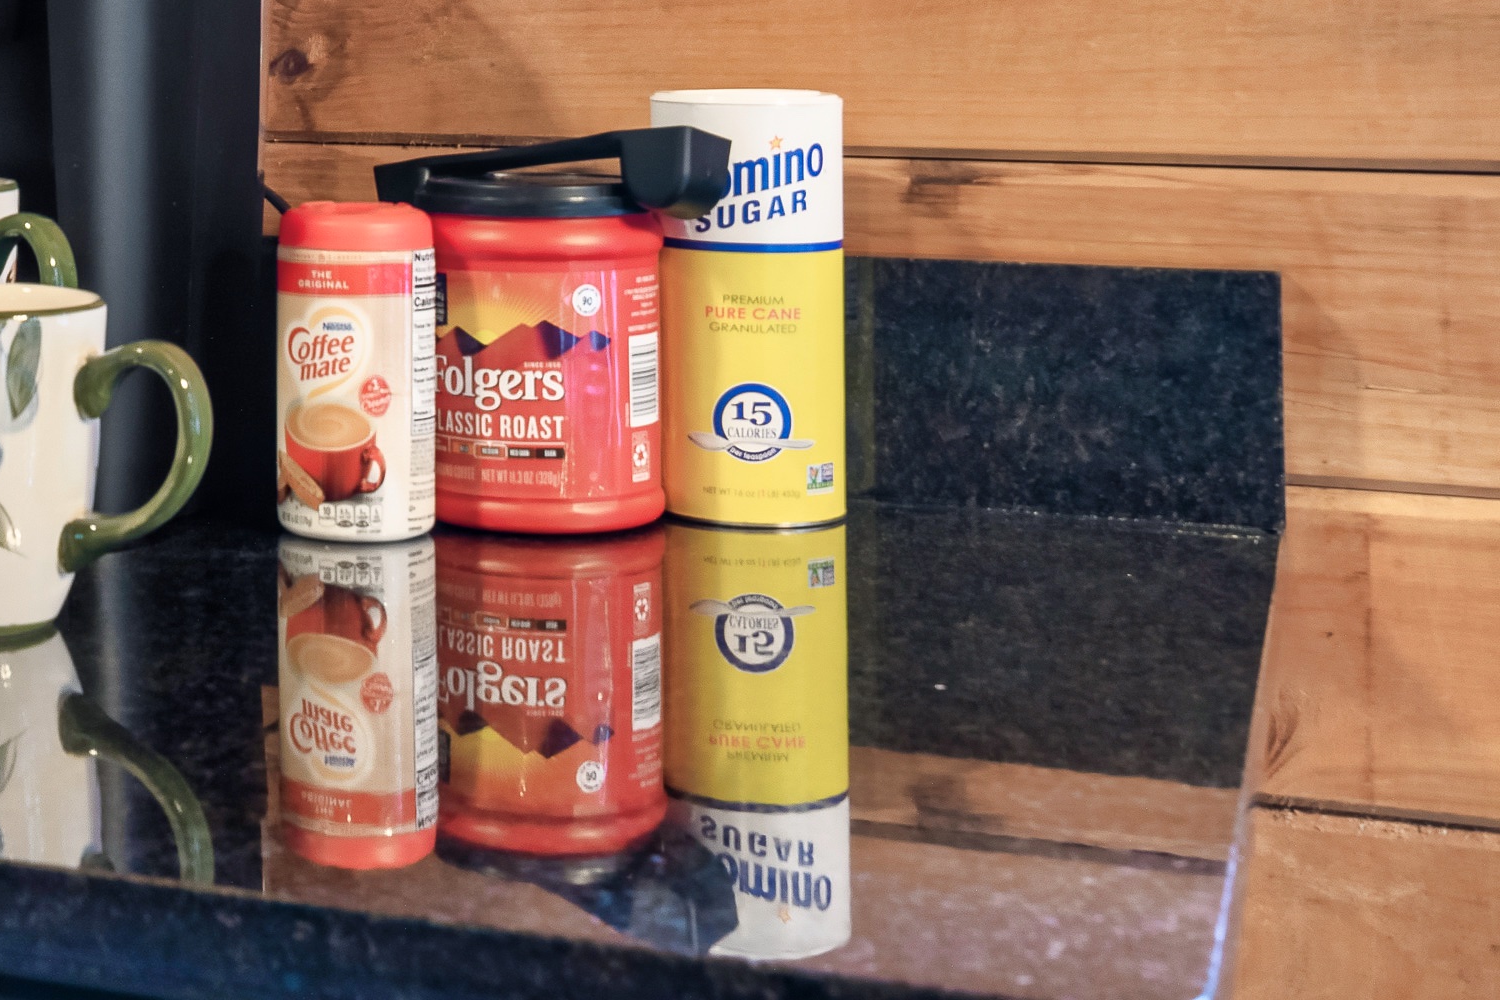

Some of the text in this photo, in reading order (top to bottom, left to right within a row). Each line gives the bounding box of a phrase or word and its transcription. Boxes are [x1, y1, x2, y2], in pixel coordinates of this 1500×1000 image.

[718, 142, 824, 201] omino
[695, 189, 807, 233] SUGAR
[298, 280, 349, 289] ORIGINAL
[311, 270, 332, 279] THE
[722, 294, 784, 305] PREMIUM
[705, 306, 800, 320] PURE CANE
[709, 321, 797, 334] GRANULATED
[288, 326, 354, 365] Coffee
[300, 357, 351, 381] mate
[435, 354, 565, 411] Folgers
[436, 408, 493, 437] LASSIC
[499, 414, 565, 439] ROAST
[731, 401, 772, 426] 15
[727, 426, 777, 439] CALORIES
